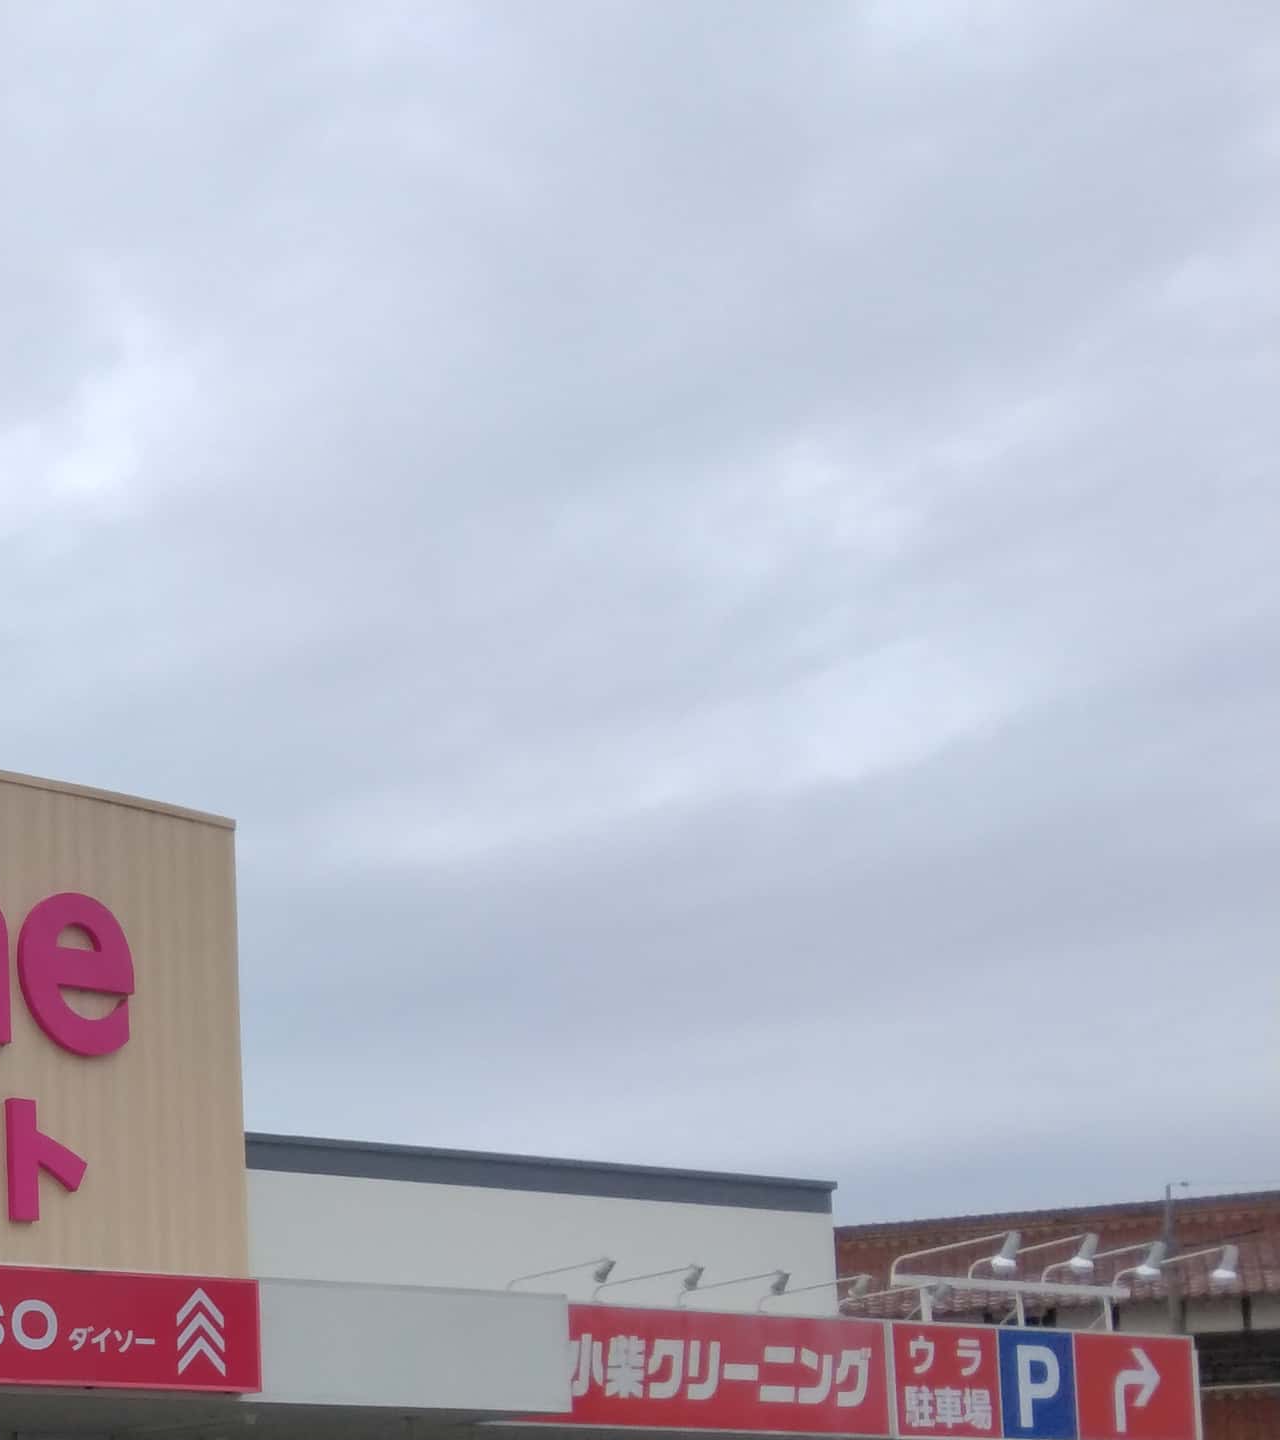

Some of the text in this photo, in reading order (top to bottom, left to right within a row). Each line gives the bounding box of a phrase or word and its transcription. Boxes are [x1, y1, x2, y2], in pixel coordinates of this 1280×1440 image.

[68, 1325, 157, 1354] ダイソー
[909, 1334, 982, 1377] ウラ
[572, 1333, 871, 1408] 小柴クリーニング
[1016, 1344, 1061, 1428] P
[904, 1386, 993, 1431] 駐車場
